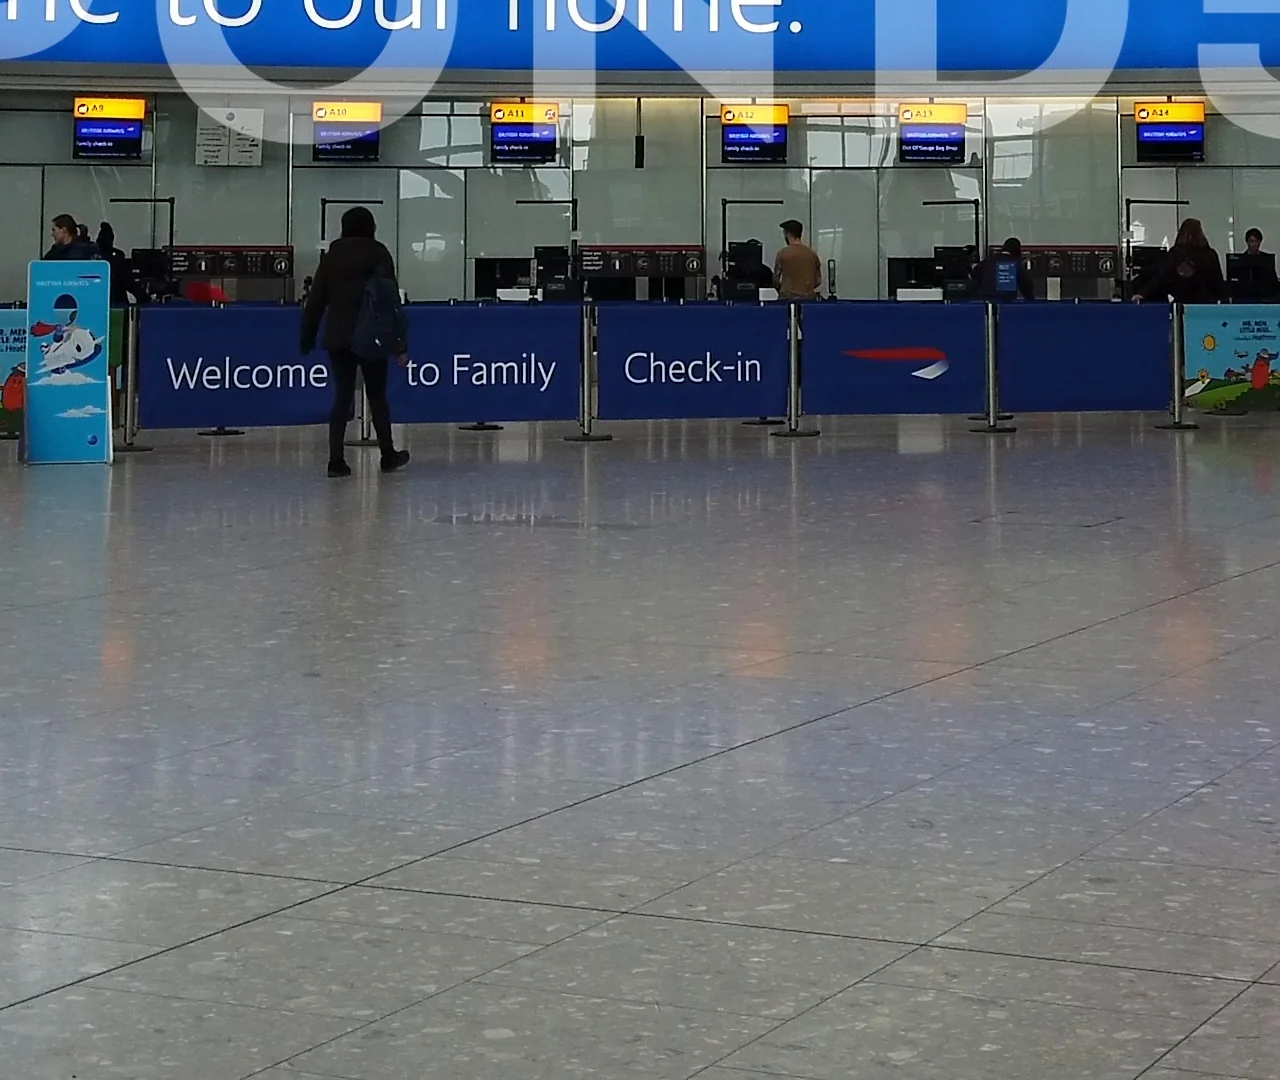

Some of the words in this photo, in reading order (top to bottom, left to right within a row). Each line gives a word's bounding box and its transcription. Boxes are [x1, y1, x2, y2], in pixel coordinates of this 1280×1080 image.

[91, 104, 104, 113] A9
[329, 108, 347, 116] A10
[507, 109, 525, 118] A11
[737, 111, 755, 119] A12
[624, 351, 761, 384] Check-in
[166, 356, 328, 390] Welcome
[406, 359, 440, 386] to
[453, 352, 556, 393] Family
